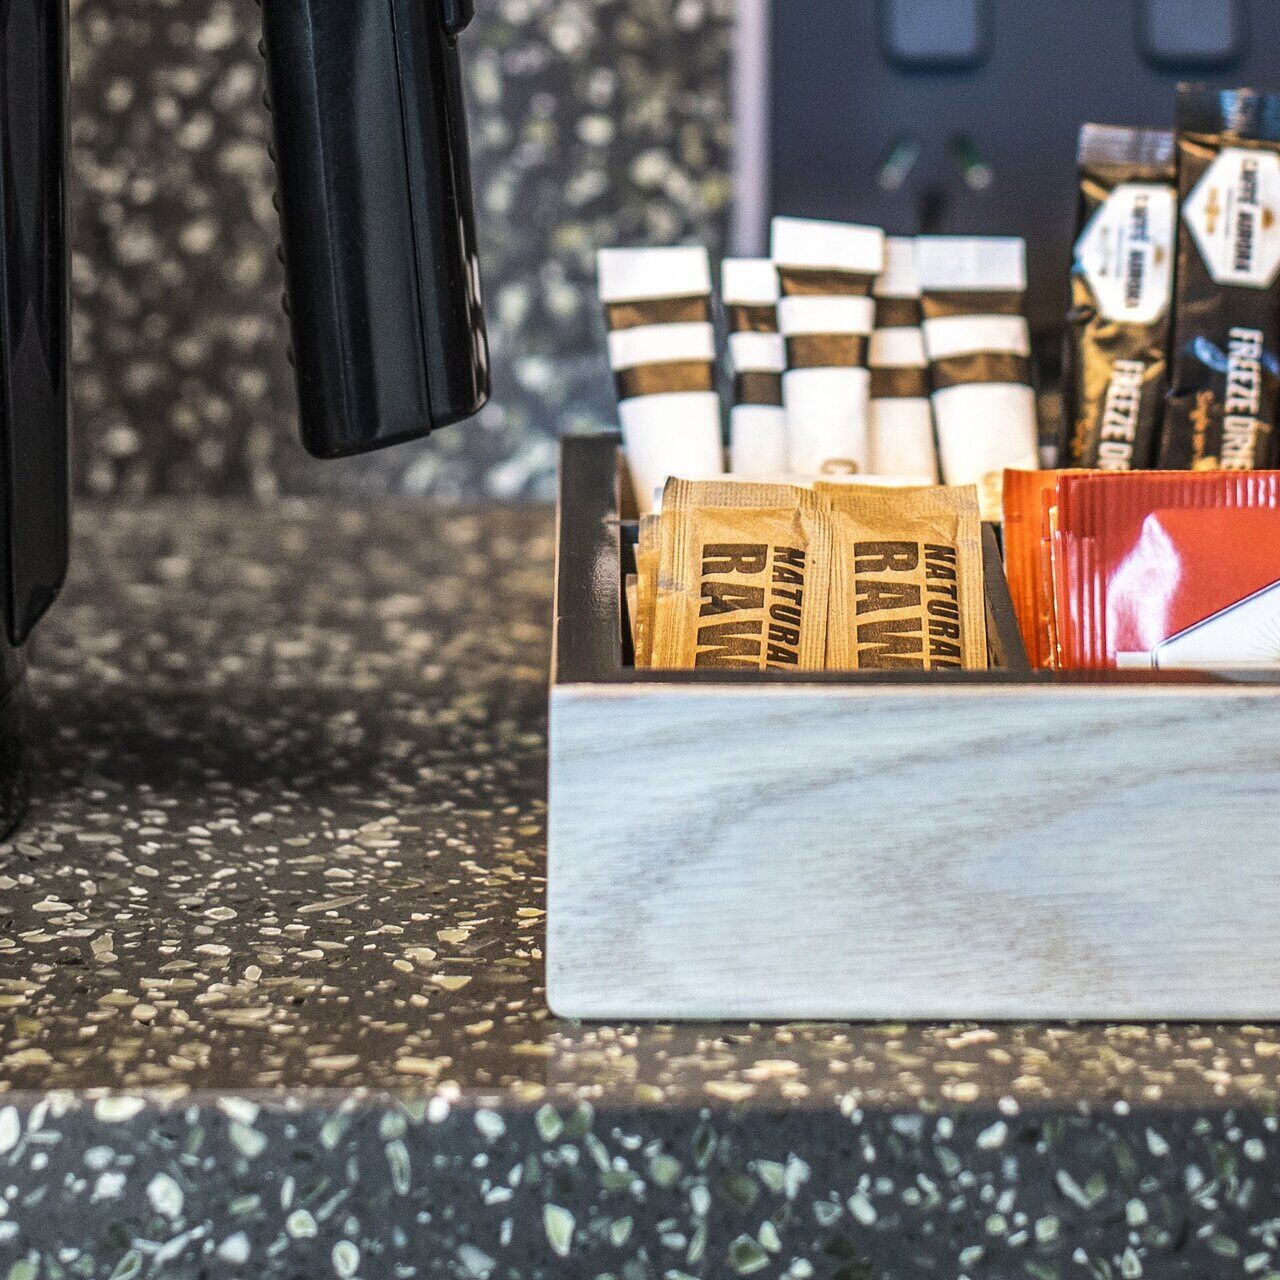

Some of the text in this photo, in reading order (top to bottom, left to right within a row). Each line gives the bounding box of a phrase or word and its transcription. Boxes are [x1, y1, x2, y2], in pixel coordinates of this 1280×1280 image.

[1101, 360, 1145, 442] FREEZE
[1220, 327, 1264, 470] FREEZE DRIE
[695, 542, 769, 670] RAW
[765, 545, 806, 670] NATURA
[854, 540, 924, 670] RAW
